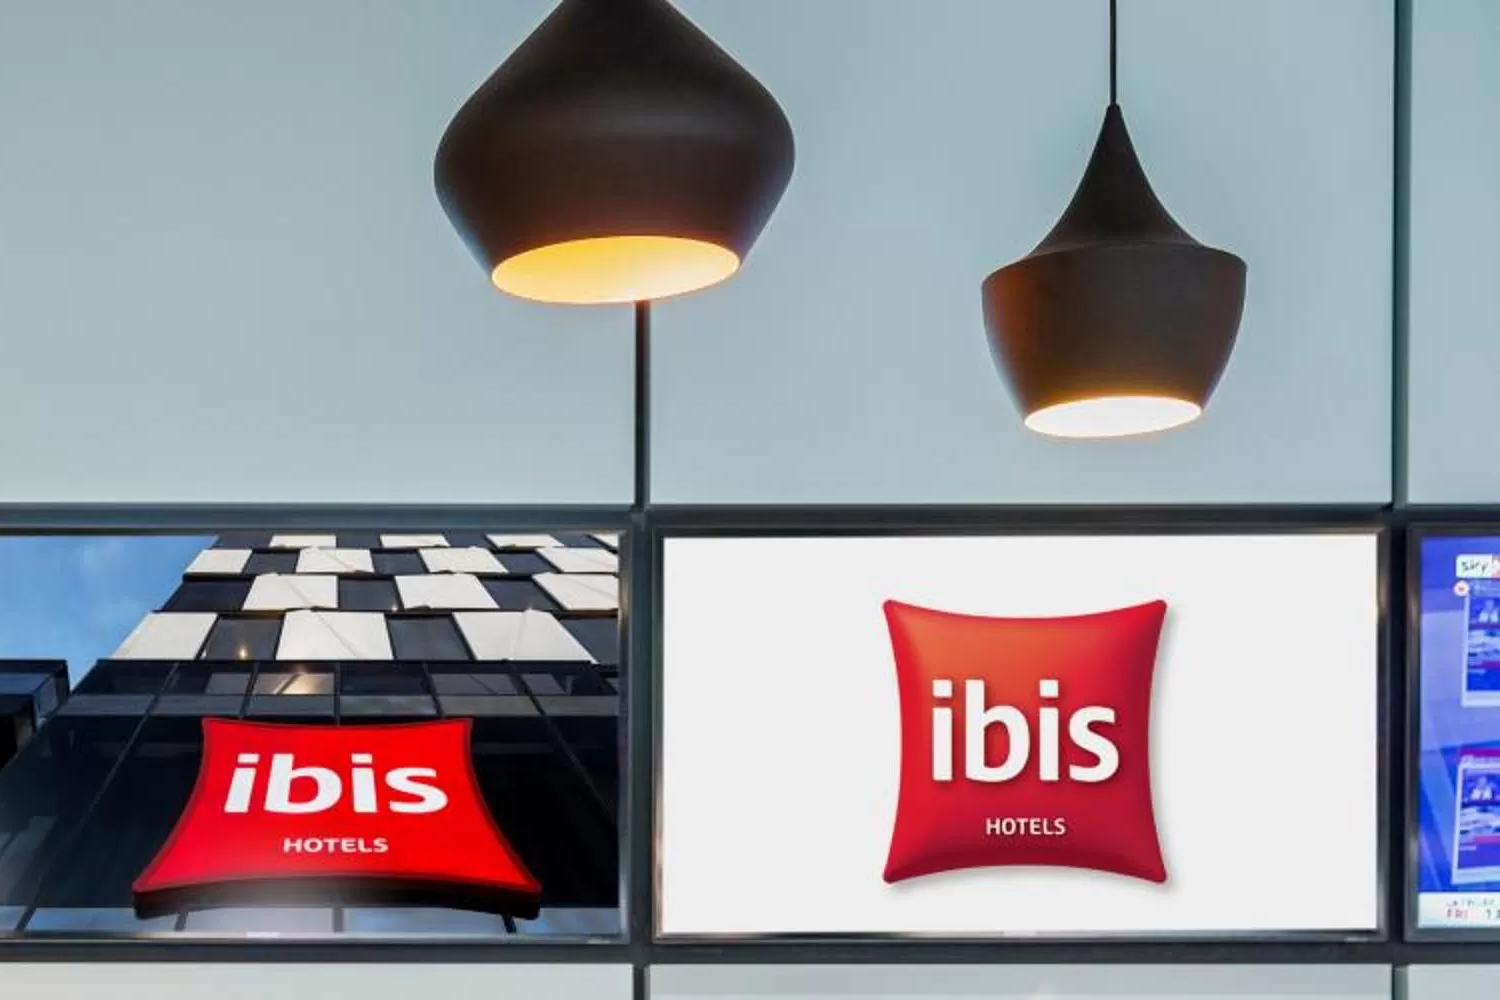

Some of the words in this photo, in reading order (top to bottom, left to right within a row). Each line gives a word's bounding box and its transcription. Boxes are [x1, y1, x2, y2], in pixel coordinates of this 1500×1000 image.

[933, 679, 1120, 783] ibis
[224, 754, 449, 813] ibis
[283, 837, 389, 854] HOTELS
[986, 818, 1067, 836] HOTELS
